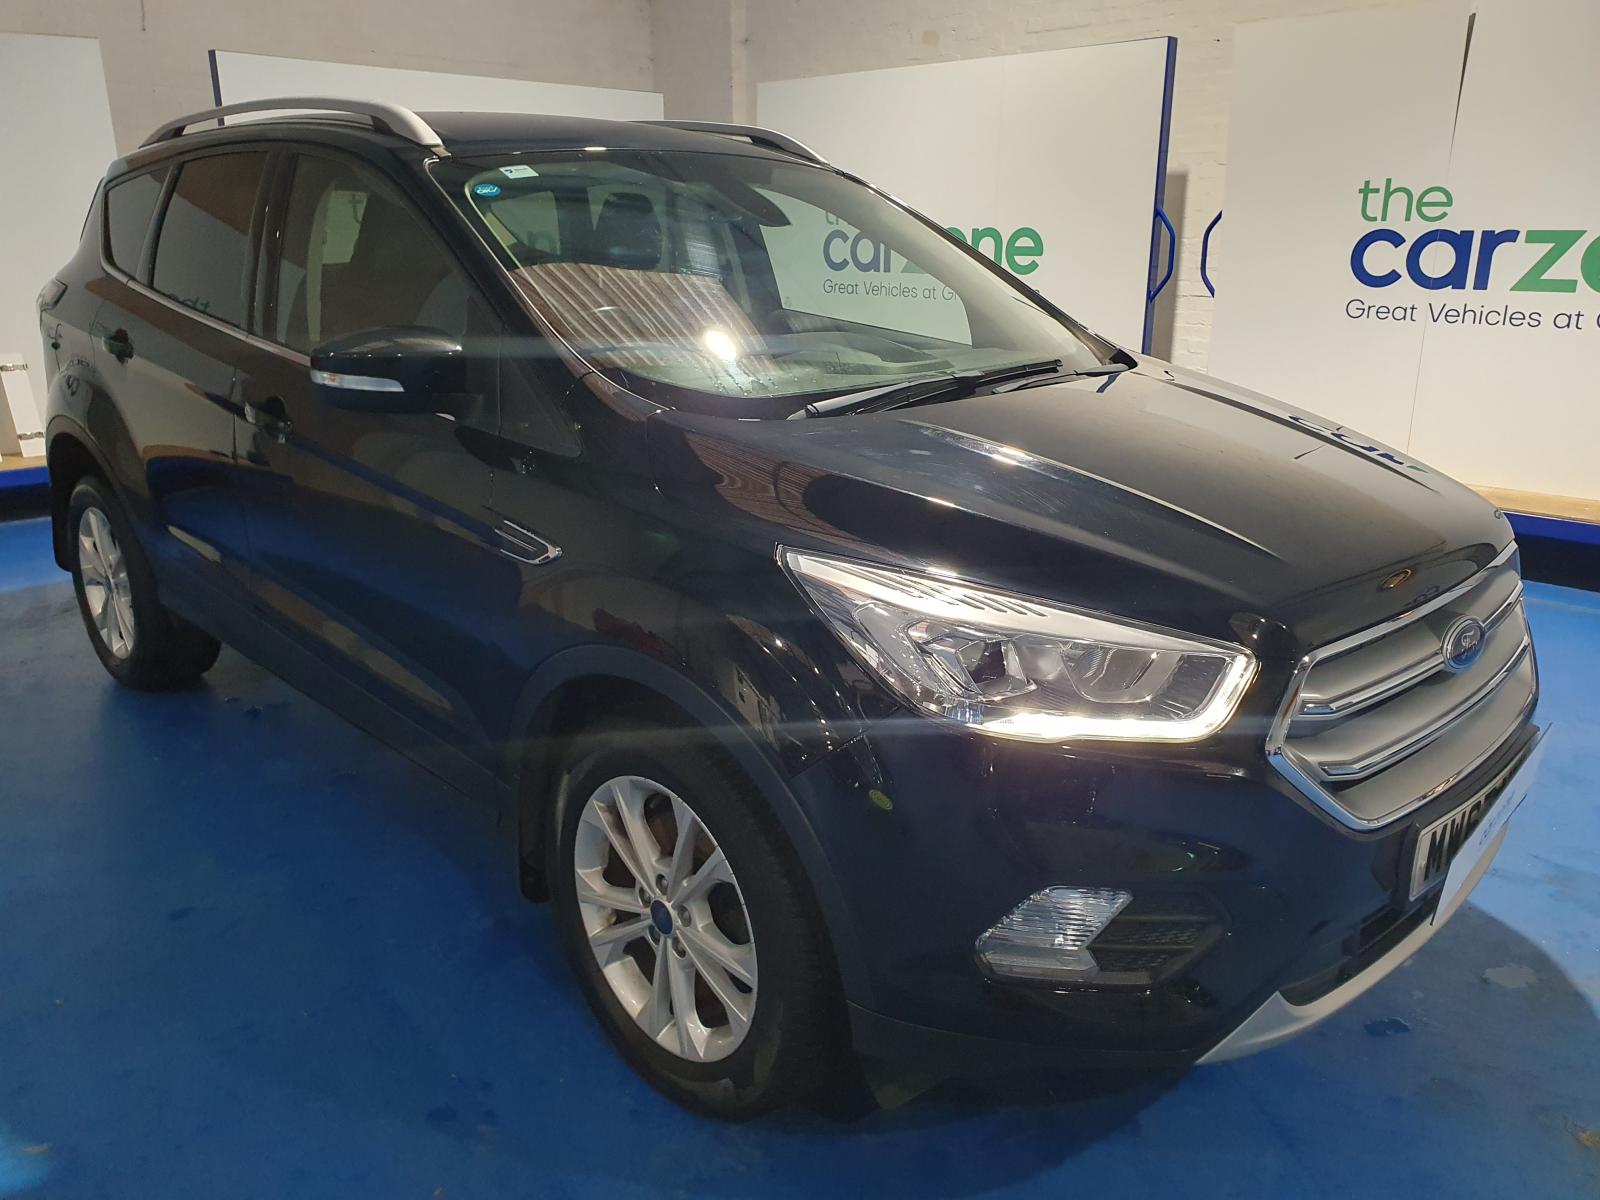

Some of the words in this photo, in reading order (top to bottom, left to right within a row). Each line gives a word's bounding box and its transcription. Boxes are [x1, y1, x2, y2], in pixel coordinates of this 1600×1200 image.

[1358, 178, 1454, 222] the
[823, 279, 859, 294] Great
[863, 281, 918, 298] Vehicles
[922, 286, 937, 300] at
[1345, 299, 1417, 322] Great
[1429, 303, 1542, 328] Vehicles
[1553, 310, 1585, 330] at
